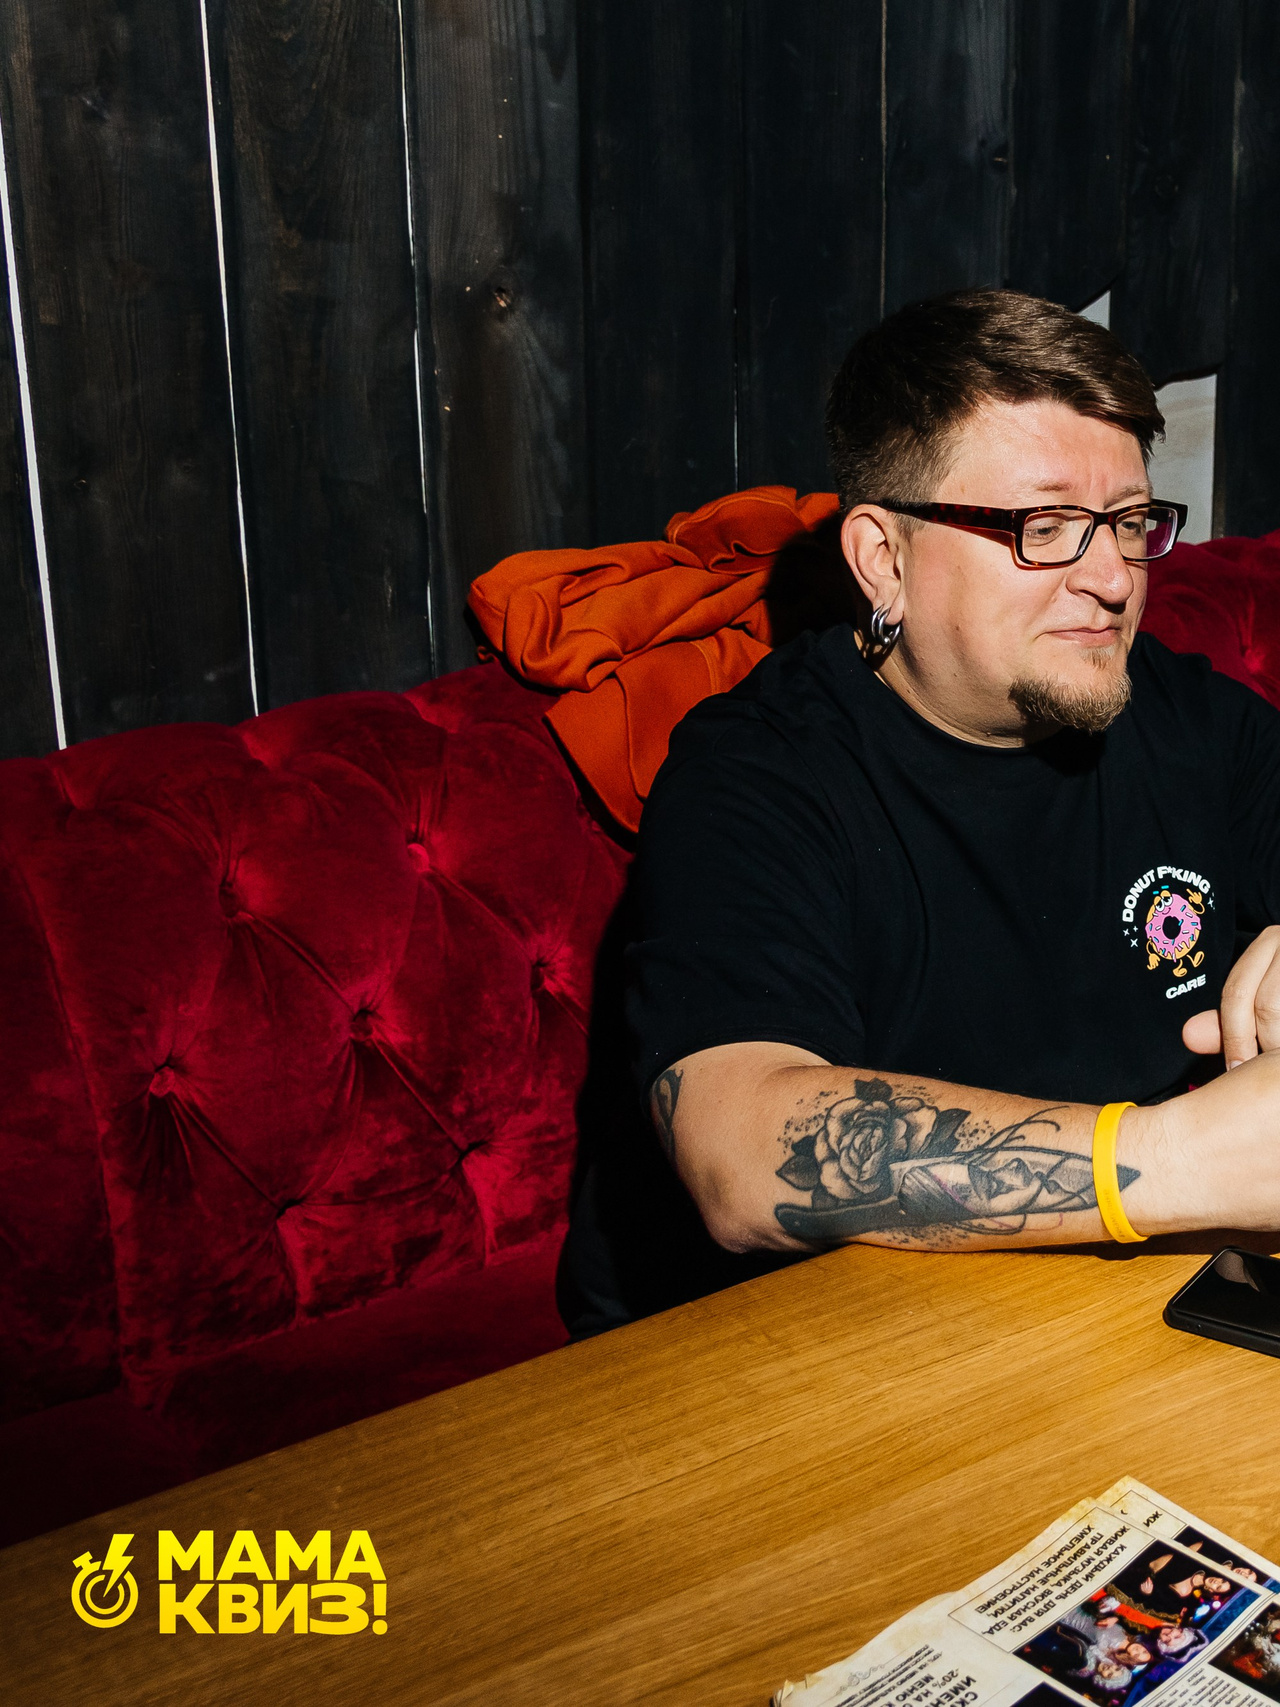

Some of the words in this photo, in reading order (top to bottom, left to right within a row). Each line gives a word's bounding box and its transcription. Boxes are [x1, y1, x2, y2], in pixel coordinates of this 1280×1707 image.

[1122, 869, 1155, 922] DONUT
[1166, 974, 1207, 999] CARE
[1041, 1524, 1095, 1568] ХМЕЛЬНОЕ
[1095, 1525, 1130, 1557] ЖИВАЯ
[1039, 1533, 1104, 1587] ПРАВИЛЬНЫЕ
[1085, 1544, 1127, 1582] КАЖДЫЙ
[1008, 1588, 1053, 1622] ВКУСНАЯ
[1055, 1582, 1083, 1602] ДЕНЬ
[1034, 1601, 1057, 1618] ДЛЯ
[895, 1674, 935, 1702] МЕНЮ
[914, 1689, 933, 1702] НА
